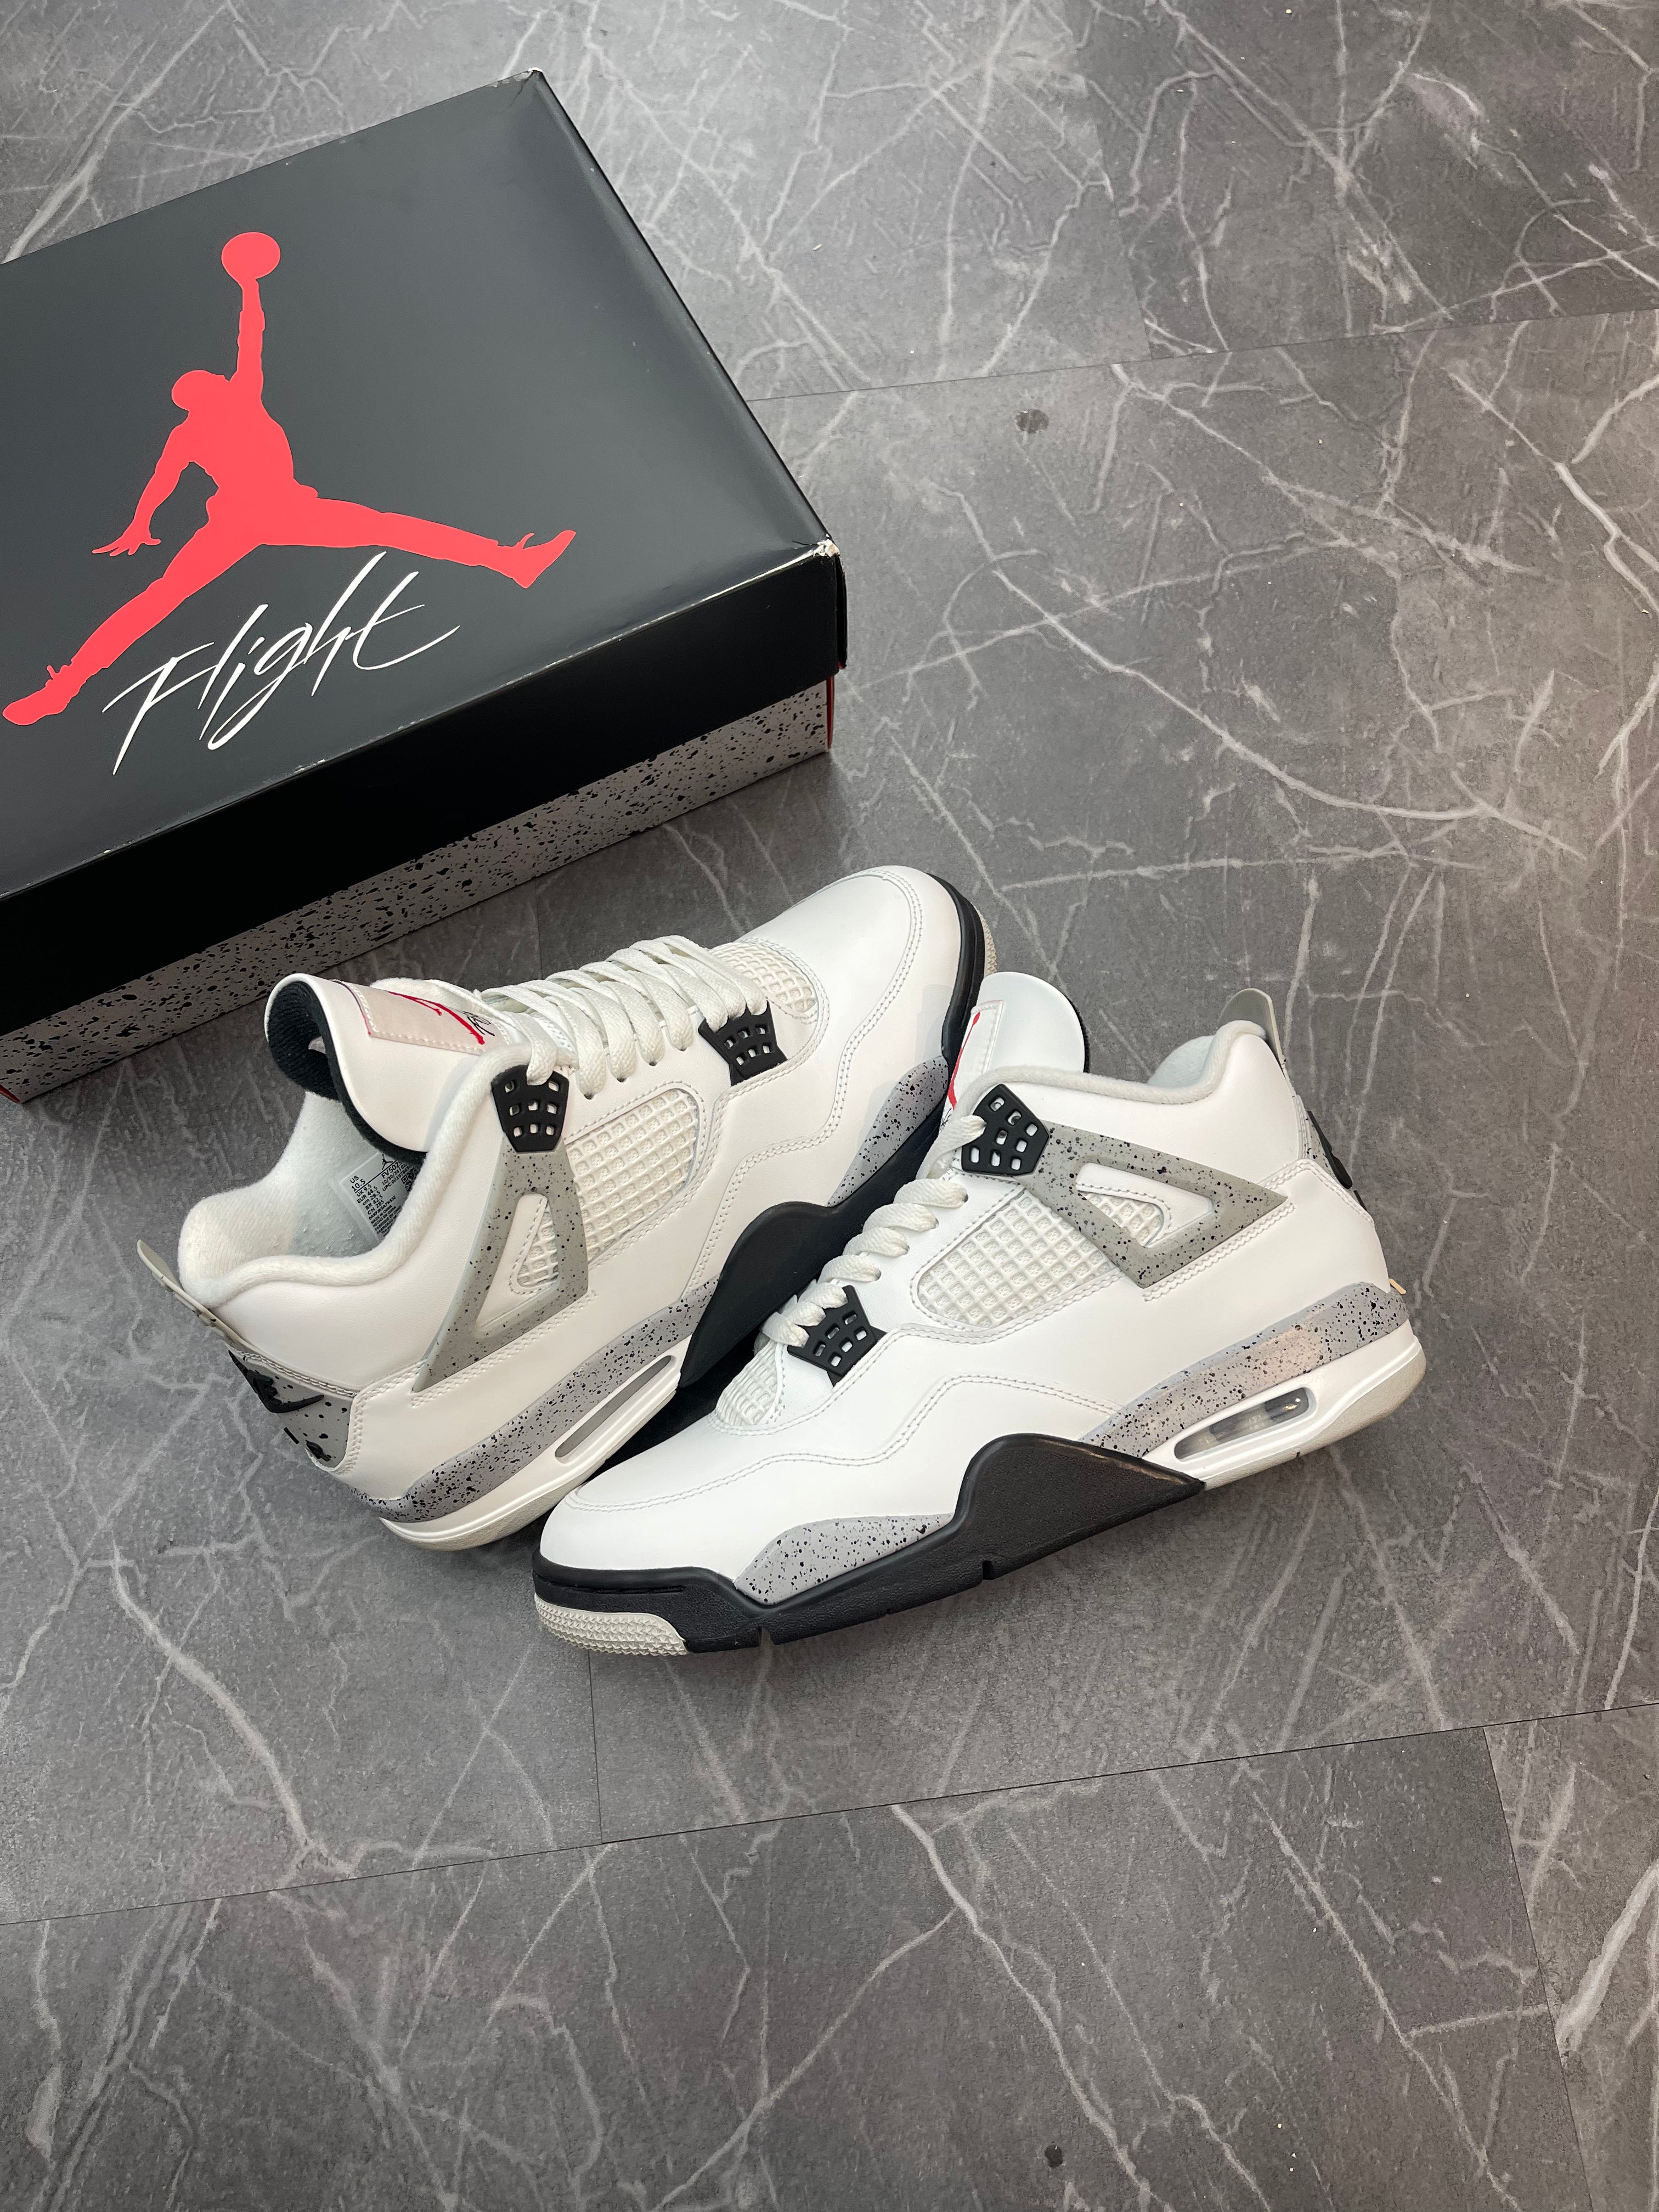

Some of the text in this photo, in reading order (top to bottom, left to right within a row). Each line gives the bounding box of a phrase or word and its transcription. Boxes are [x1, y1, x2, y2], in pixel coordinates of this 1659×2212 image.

[103, 551, 460, 775] Flight
[352, 1178, 366, 1192] 10.5
[382, 1182, 392, 1191] UPC
[357, 1186, 378, 1203] EUR 44.5
[370, 1190, 380, 1200] 28.5
[373, 1194, 383, 1204] 42.5
[376, 1200, 384, 1208] 285
